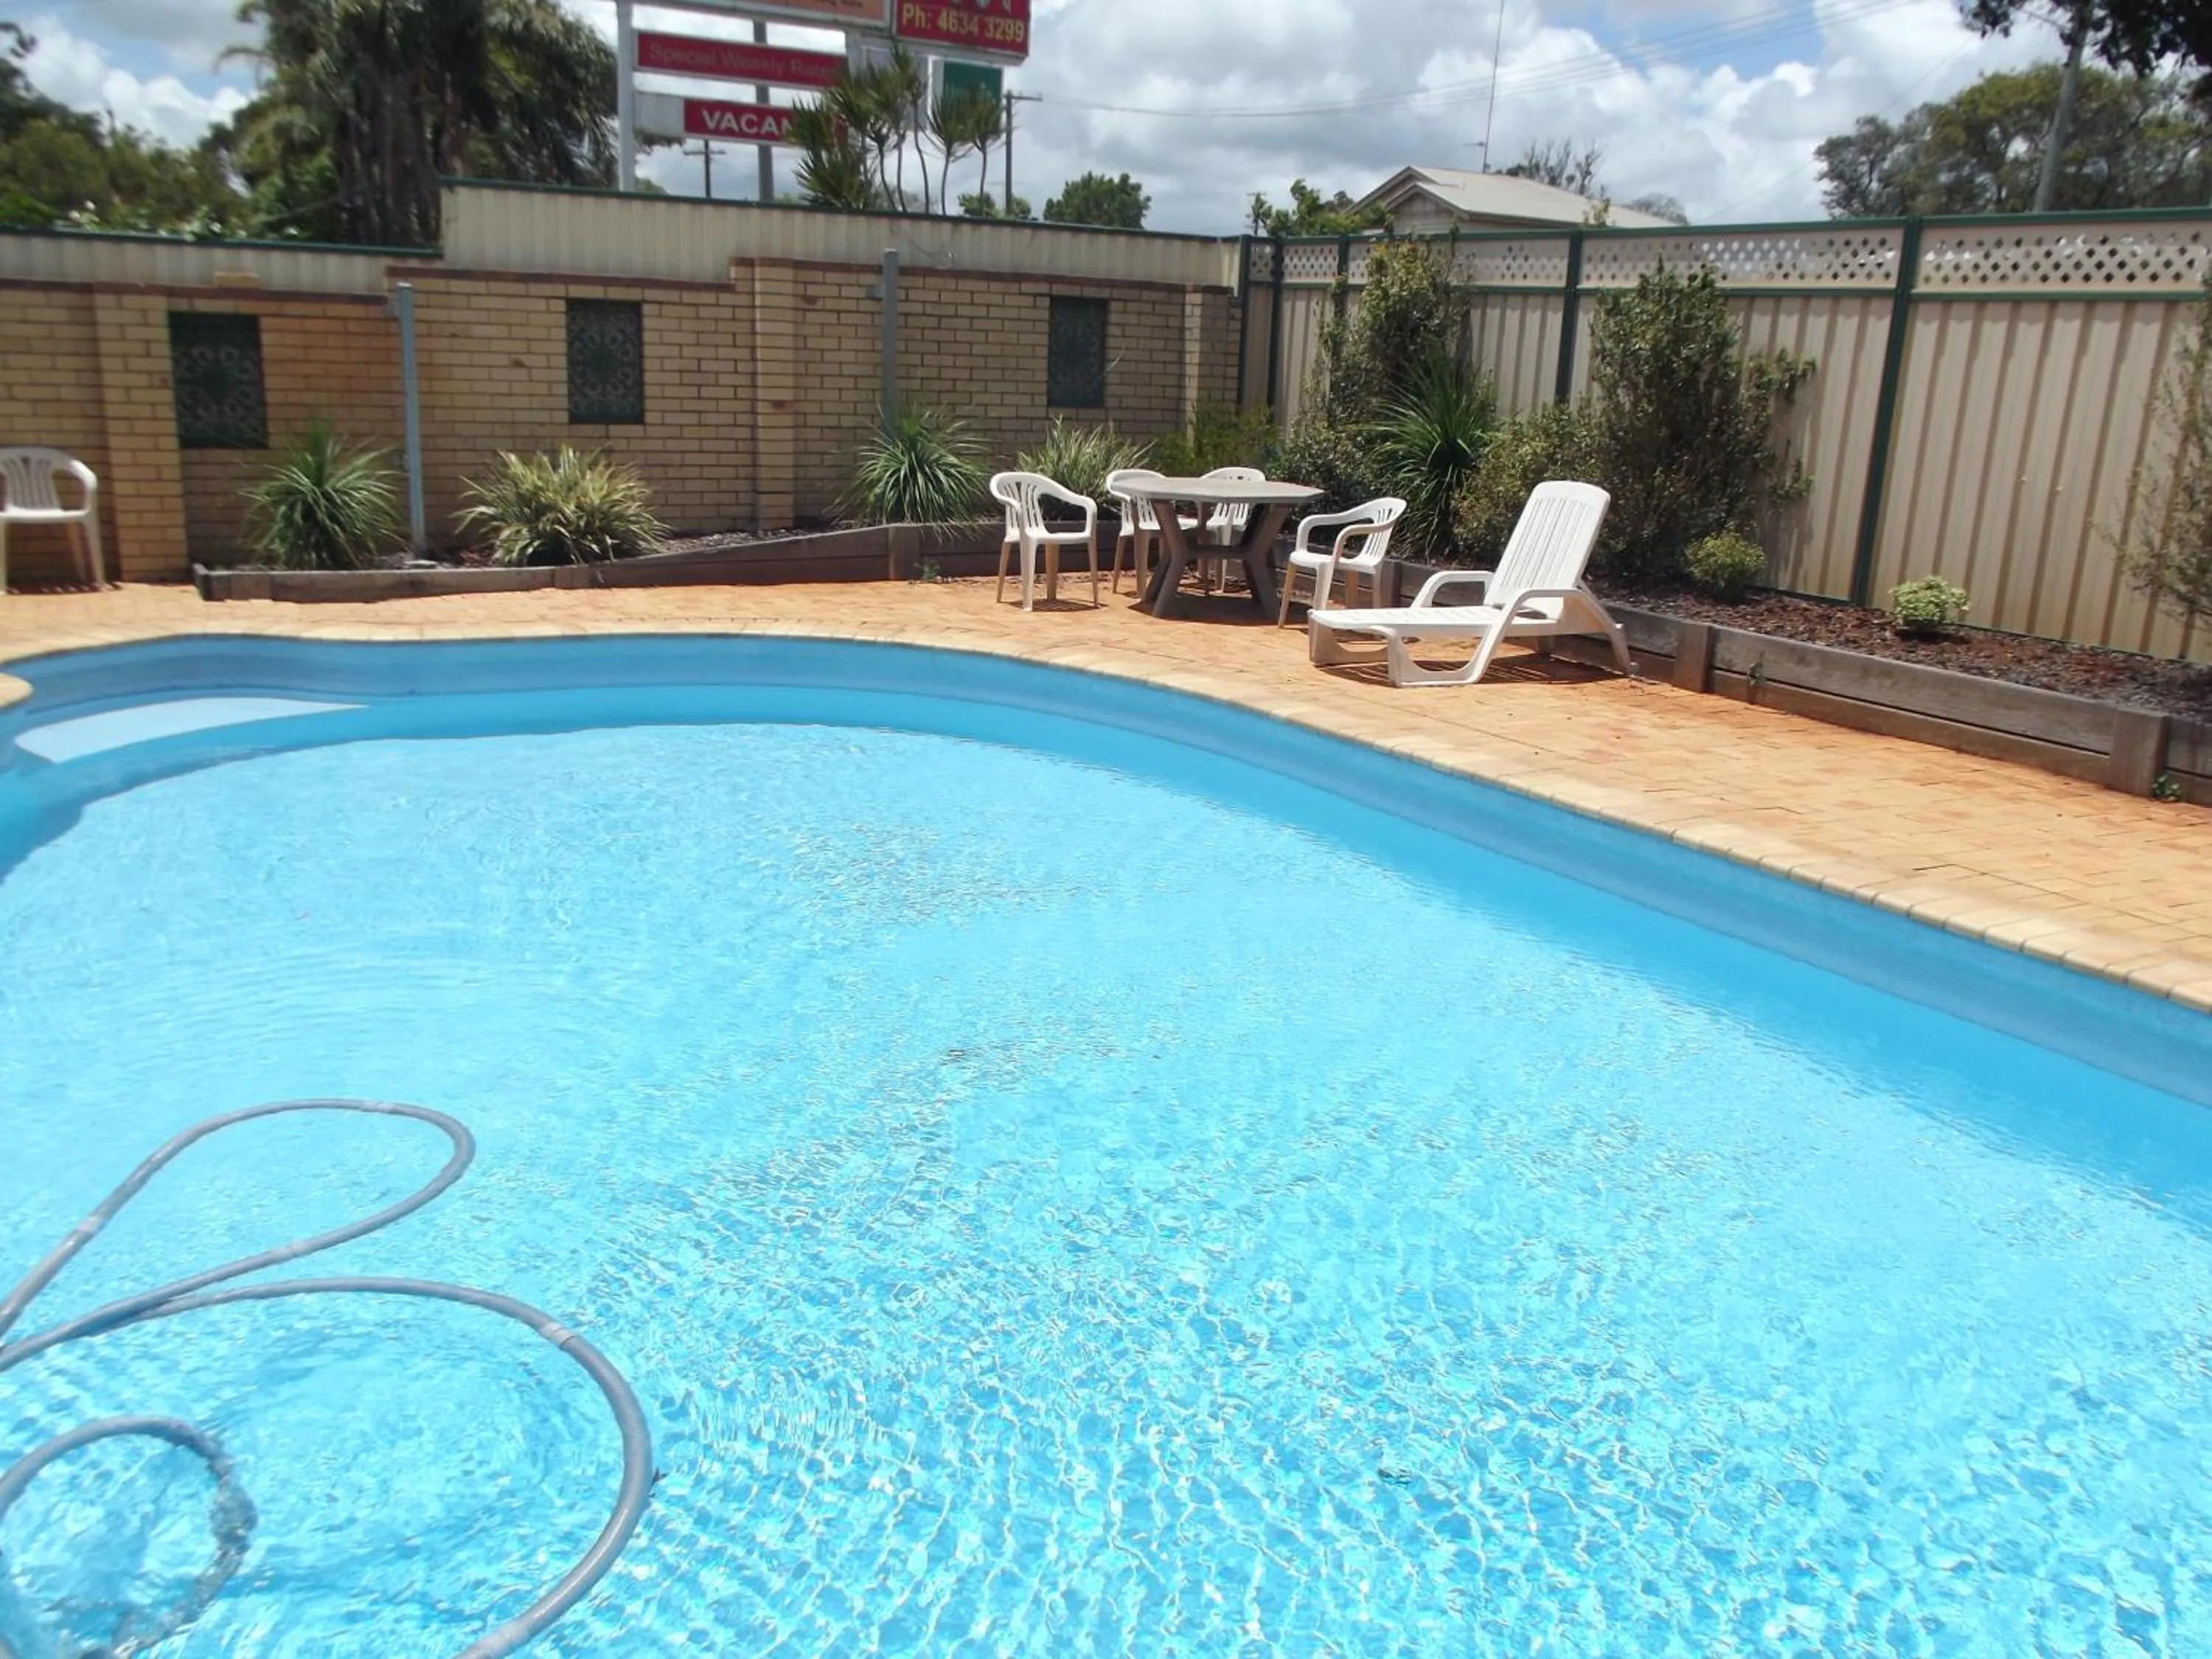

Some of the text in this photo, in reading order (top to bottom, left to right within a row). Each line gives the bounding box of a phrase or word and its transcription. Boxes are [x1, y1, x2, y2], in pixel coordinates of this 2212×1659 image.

[902, 3, 933, 29] Ph:
[937, 8, 979, 35] 4634
[984, 16, 1025, 43] 3299
[649, 41, 716, 66] Special
[720, 49, 784, 73] Weekly
[701, 109, 793, 136] VACAN
